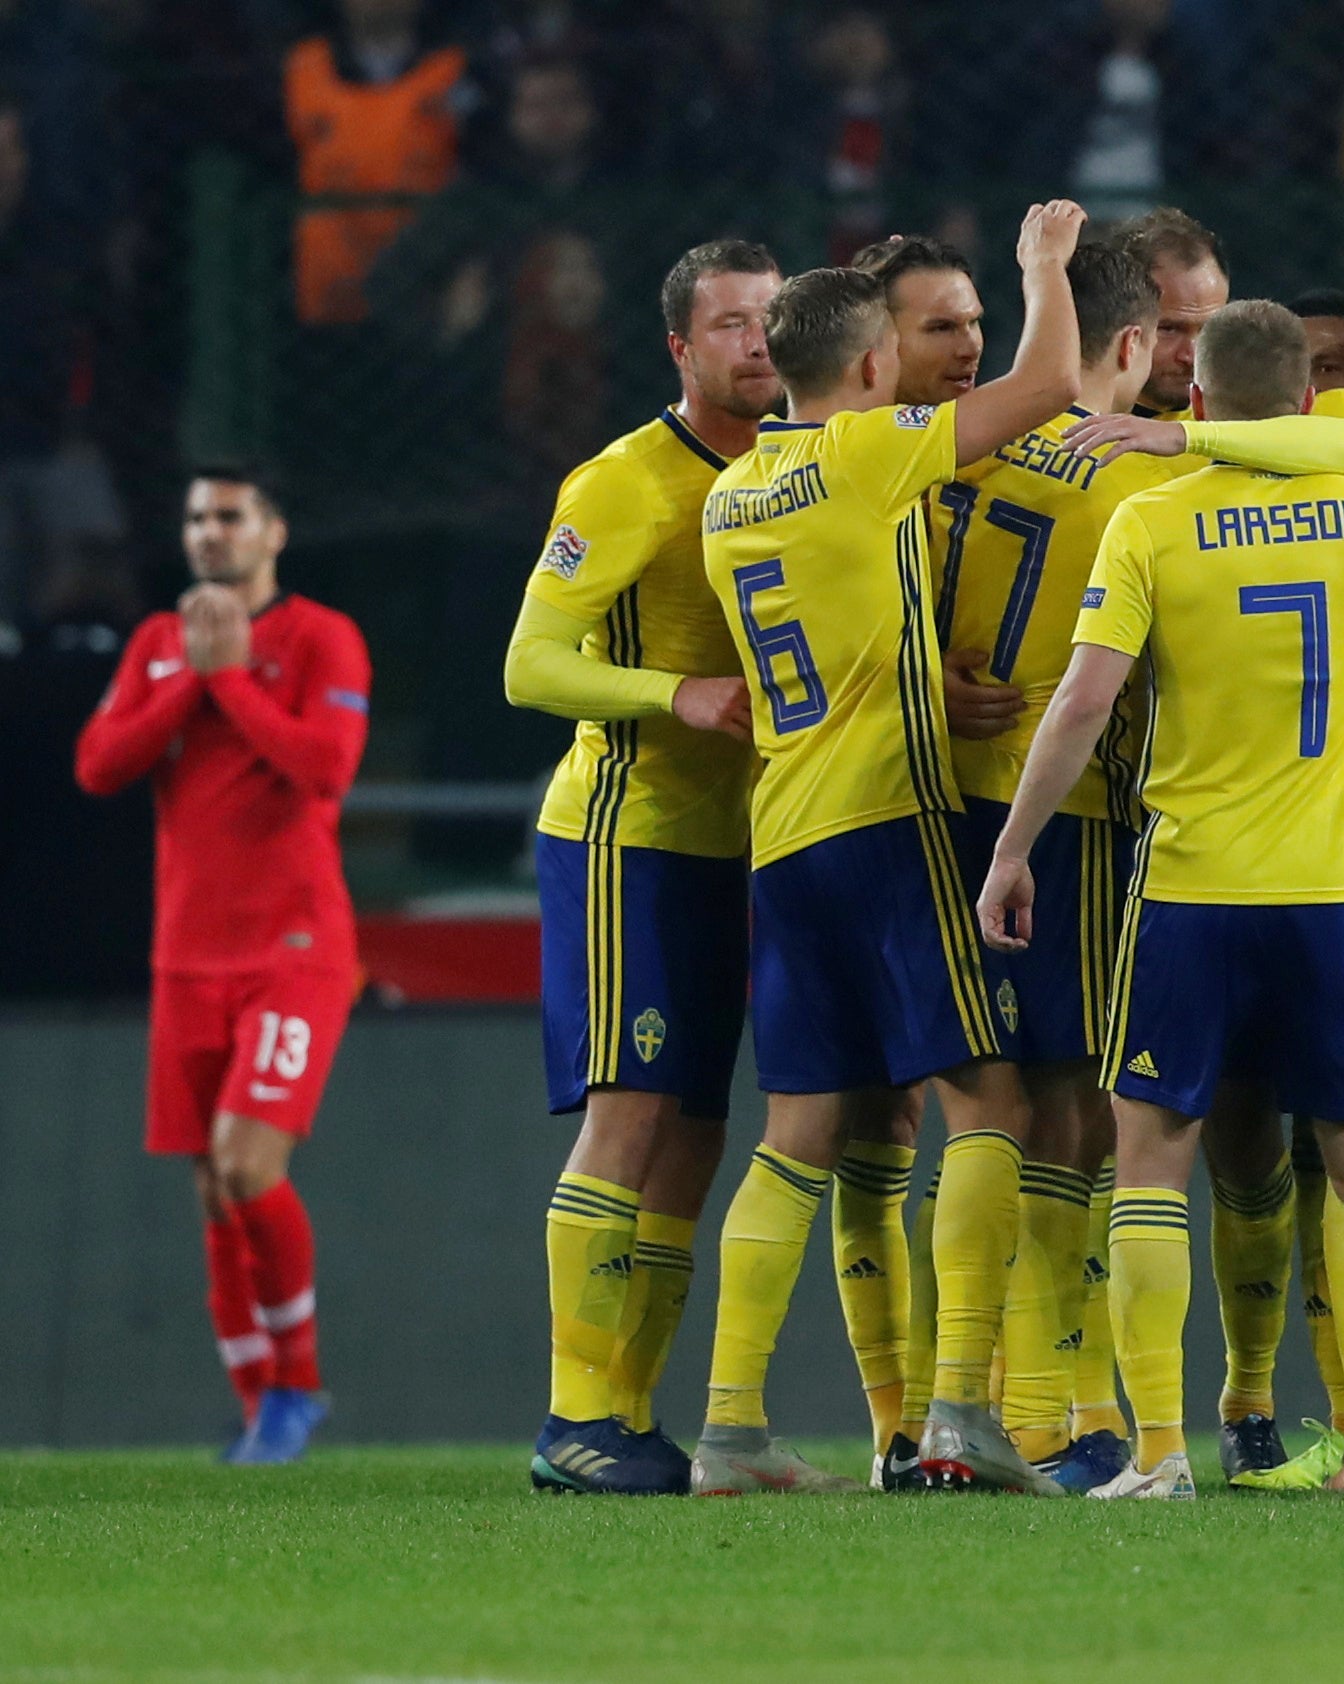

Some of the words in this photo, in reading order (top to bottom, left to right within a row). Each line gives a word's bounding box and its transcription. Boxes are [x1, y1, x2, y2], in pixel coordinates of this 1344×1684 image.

[733, 558, 828, 735] 6
[933, 480, 1056, 683] 17
[1239, 581, 1330, 758] 7
[254, 1010, 311, 1080] 13
[1127, 1063, 1159, 1078] adidas
